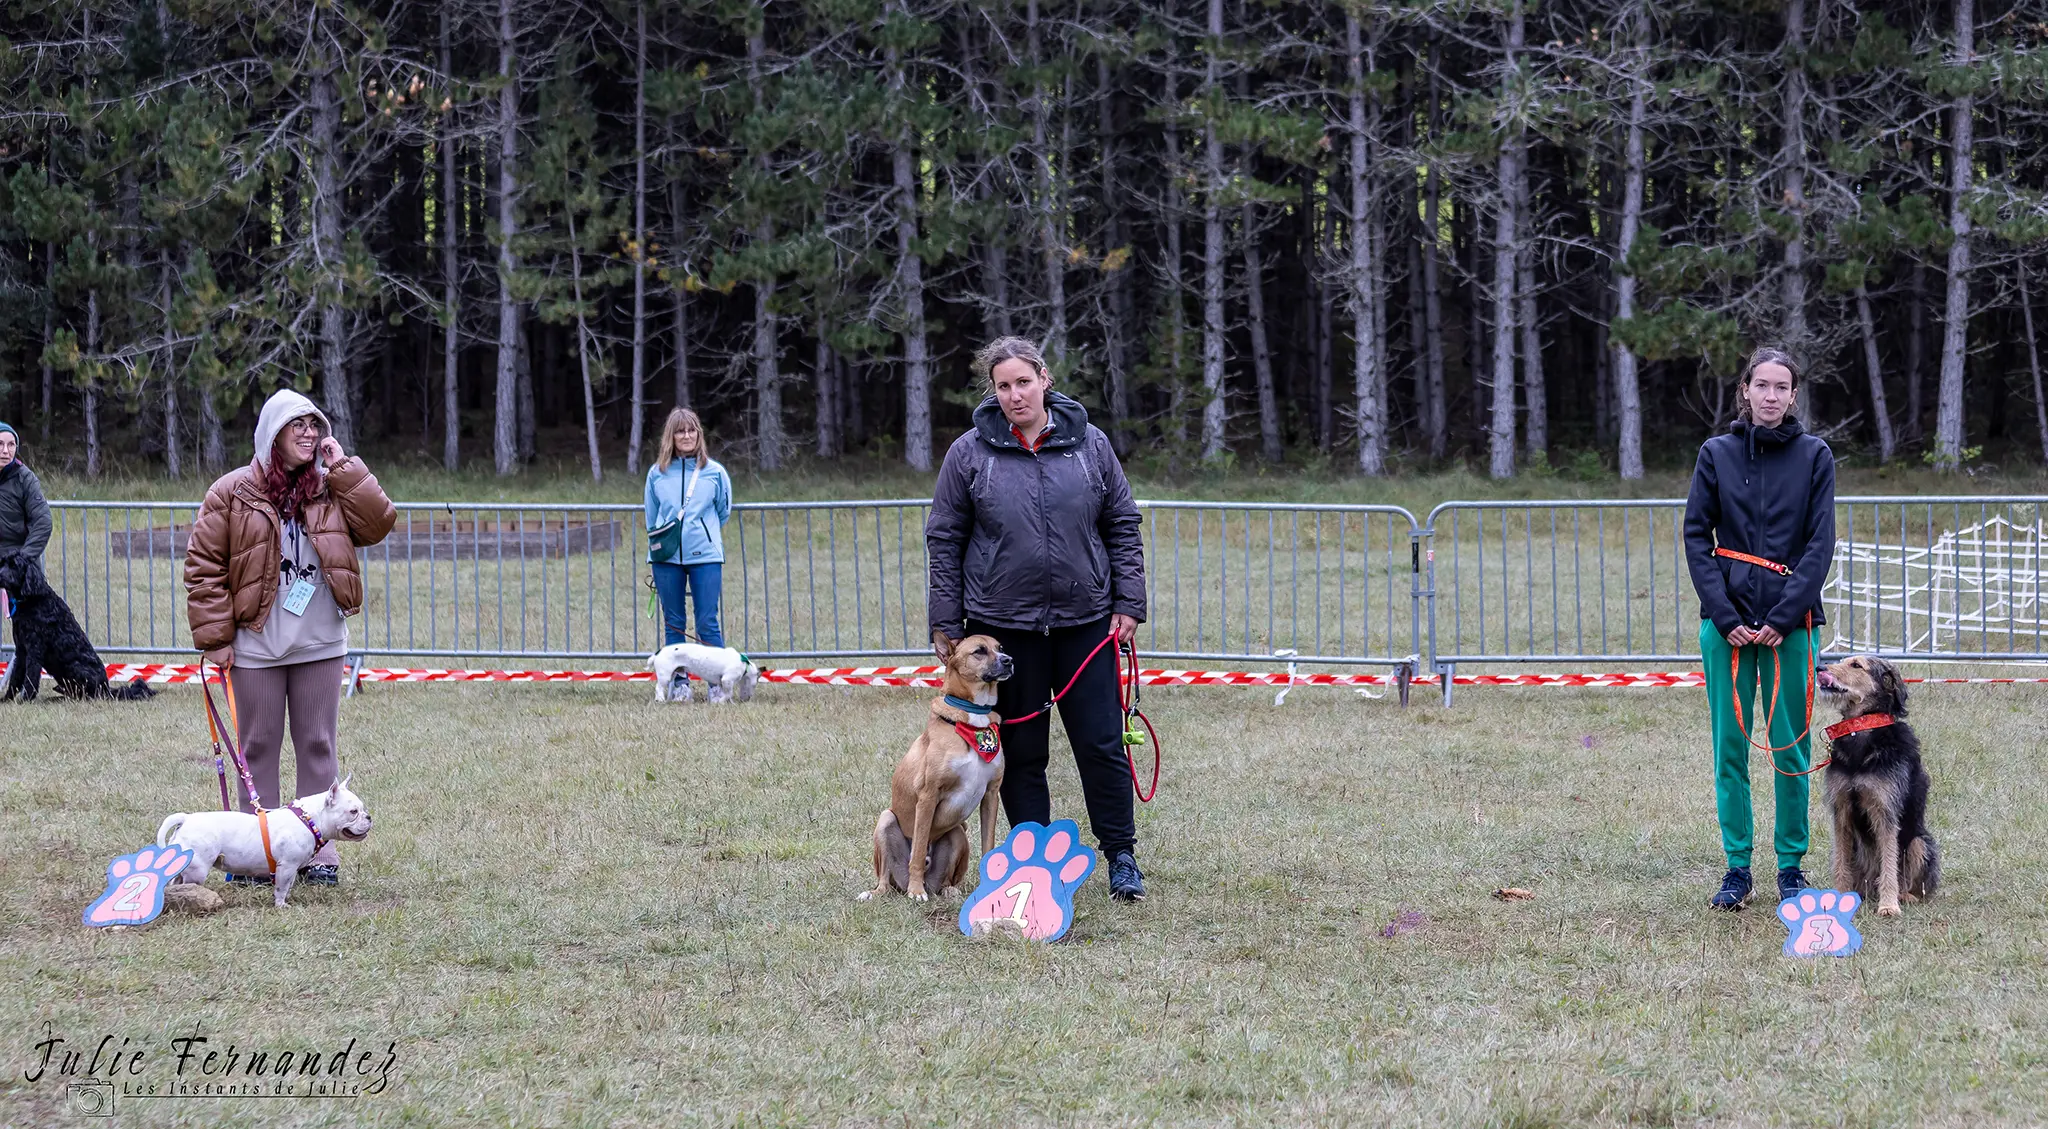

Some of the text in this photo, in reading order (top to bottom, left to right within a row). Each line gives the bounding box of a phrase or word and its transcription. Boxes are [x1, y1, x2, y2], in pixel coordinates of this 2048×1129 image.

[112, 875, 151, 912] 2
[1003, 881, 1033, 929] 1
[1809, 918, 1834, 951] 3
